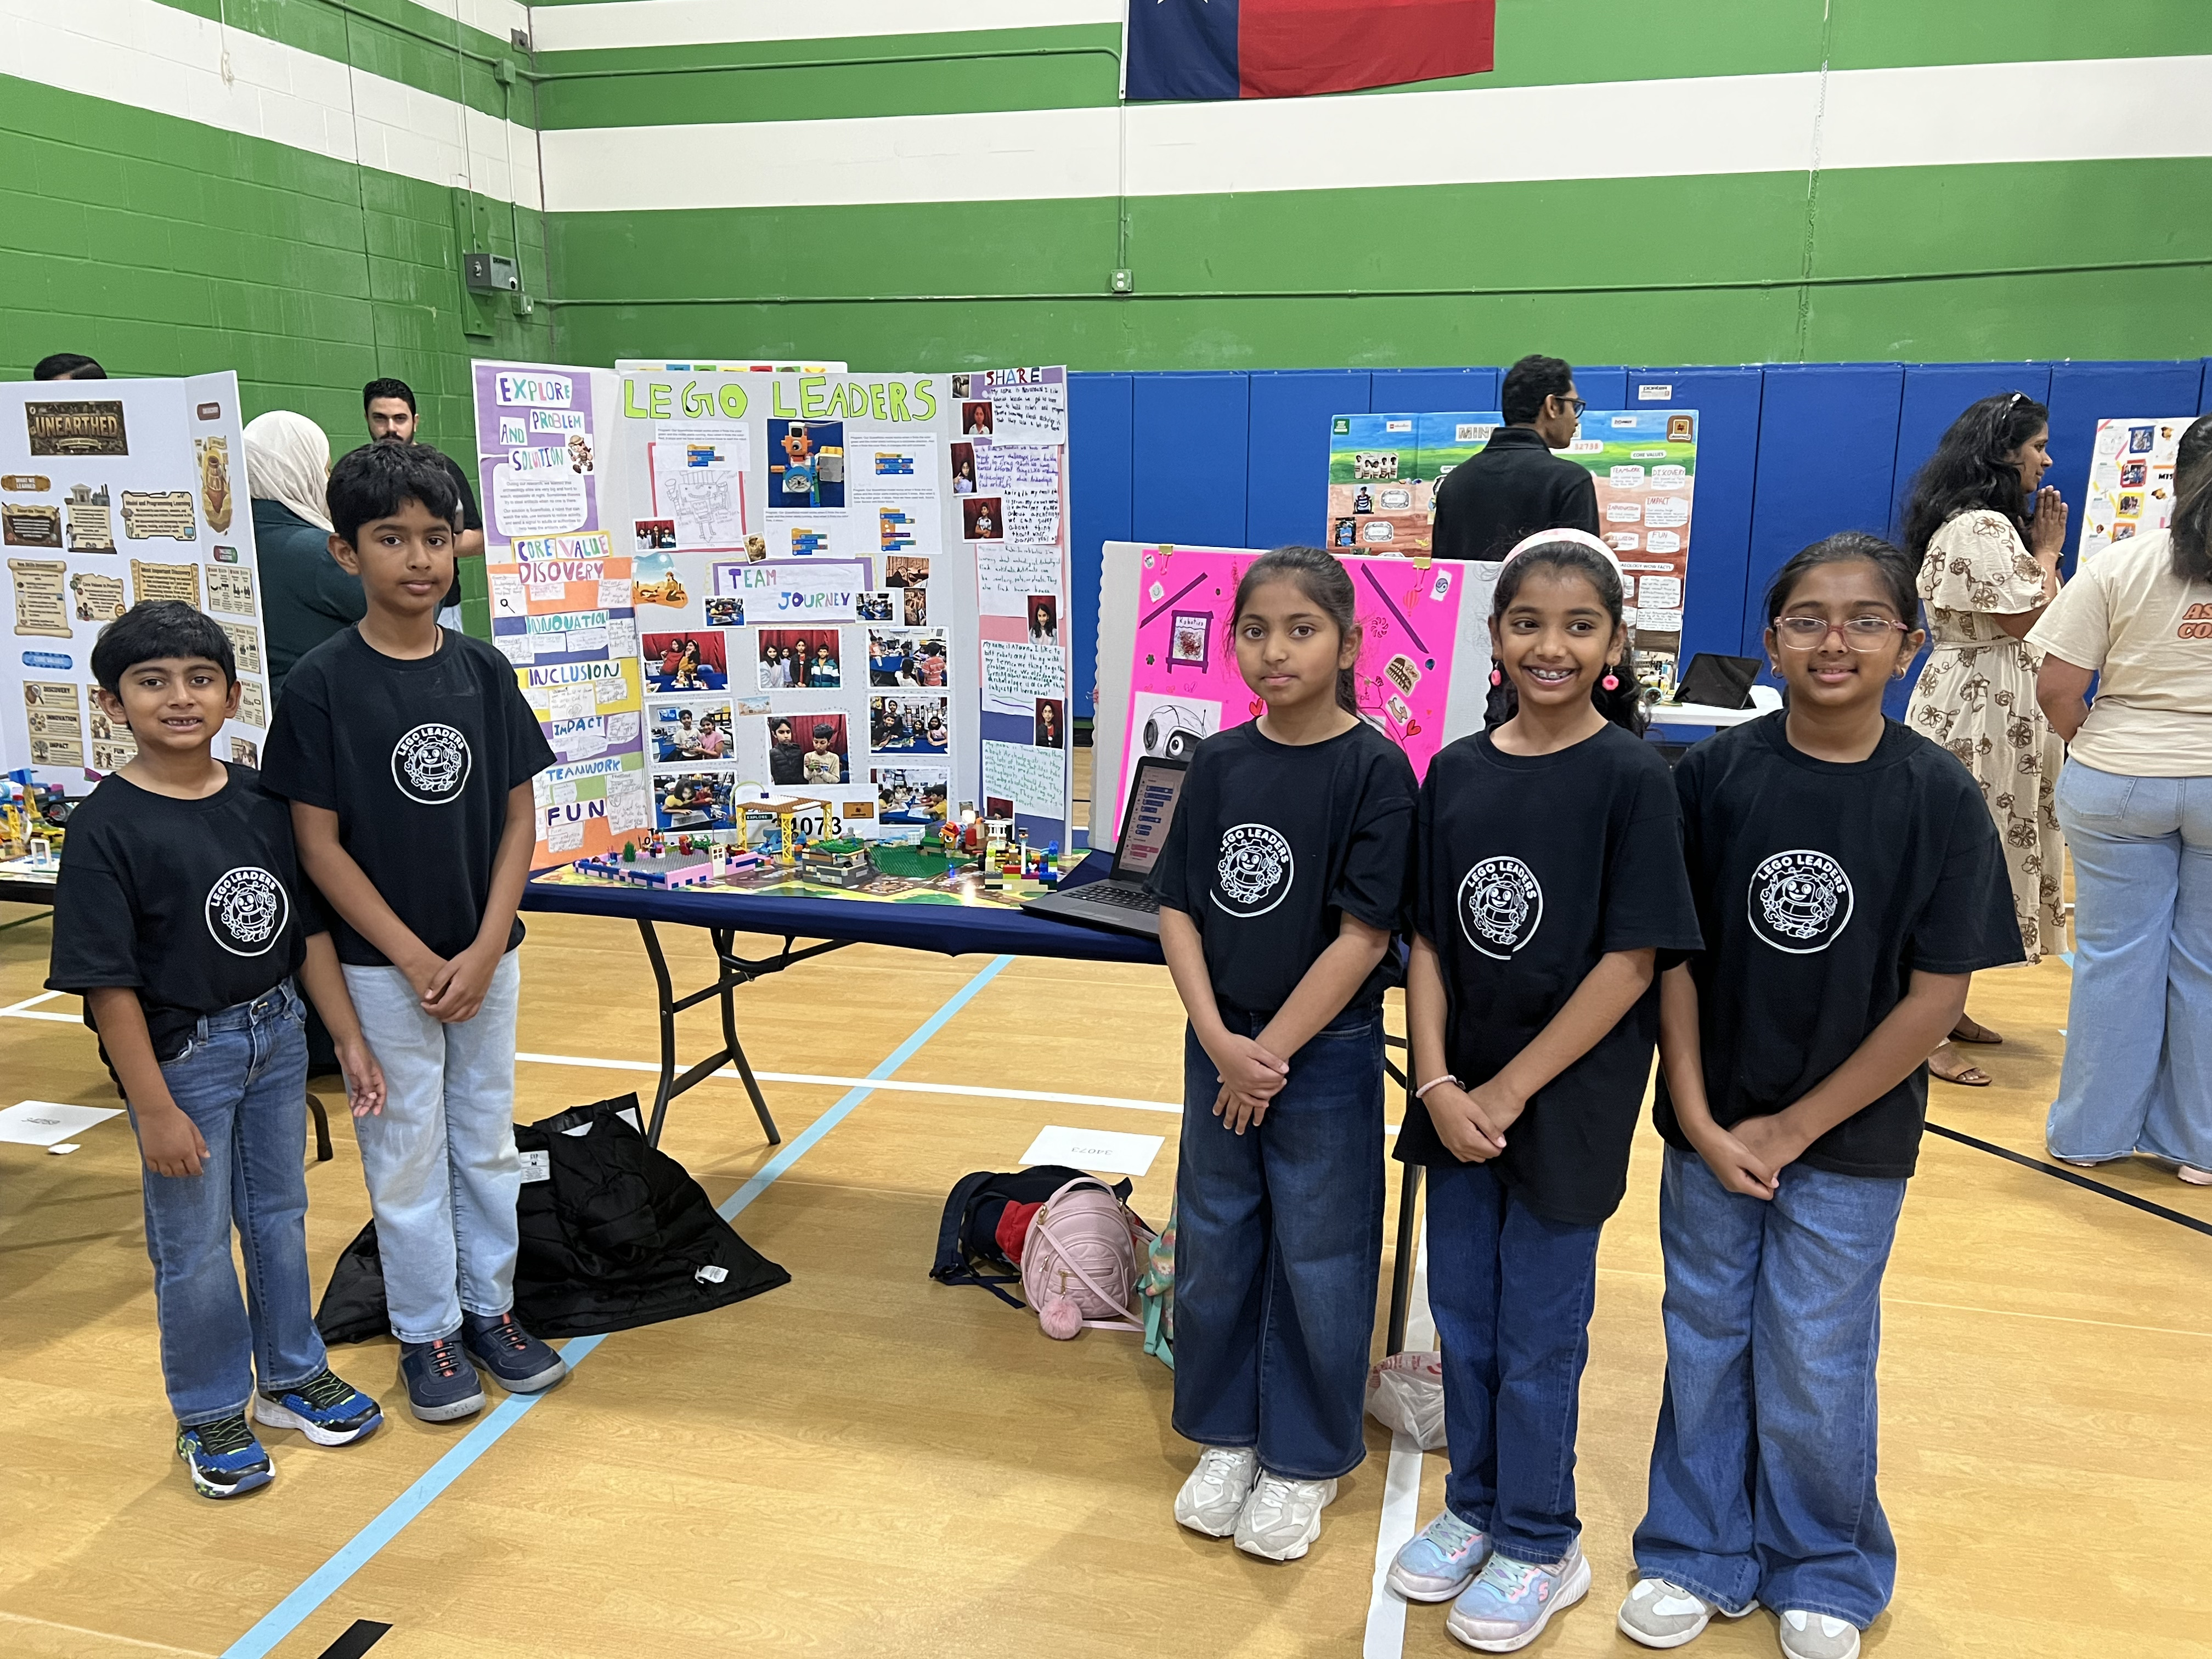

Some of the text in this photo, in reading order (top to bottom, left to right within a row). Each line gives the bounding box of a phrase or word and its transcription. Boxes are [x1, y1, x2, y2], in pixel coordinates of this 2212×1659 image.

[986, 366, 1040, 385] SHARE
[500, 377, 571, 402] EXPLORE
[624, 376, 936, 422] LEGO LEADERS
[36, 415, 117, 438] UNEARTHED
[501, 411, 582, 443] AND PROBLEM
[1458, 427, 1496, 439] MIN
[512, 447, 563, 471] SOLUTION
[518, 534, 608, 562] CORE VALUE
[518, 562, 603, 583] DISOVERY
[728, 568, 777, 589] TEAM
[778, 592, 850, 610] JOURNEY
[526, 610, 608, 634] INNOVATION
[2177, 622, 2212, 639] CO
[528, 663, 619, 686] INCLUSION
[397, 727, 464, 756] LEGO LEADERS
[546, 759, 620, 781] TEAMWORK
[1049, 782, 1062, 795] They
[548, 799, 604, 826] FUN
[1248, 828, 1289, 863] LEADERS
[1467, 861, 1537, 899] LEGO LEADERS
[1758, 855, 1846, 893] LEGO LEADERS
[211, 871, 276, 907] LEGO LEADERS
[1071, 1147, 1113, 1155] 34073
